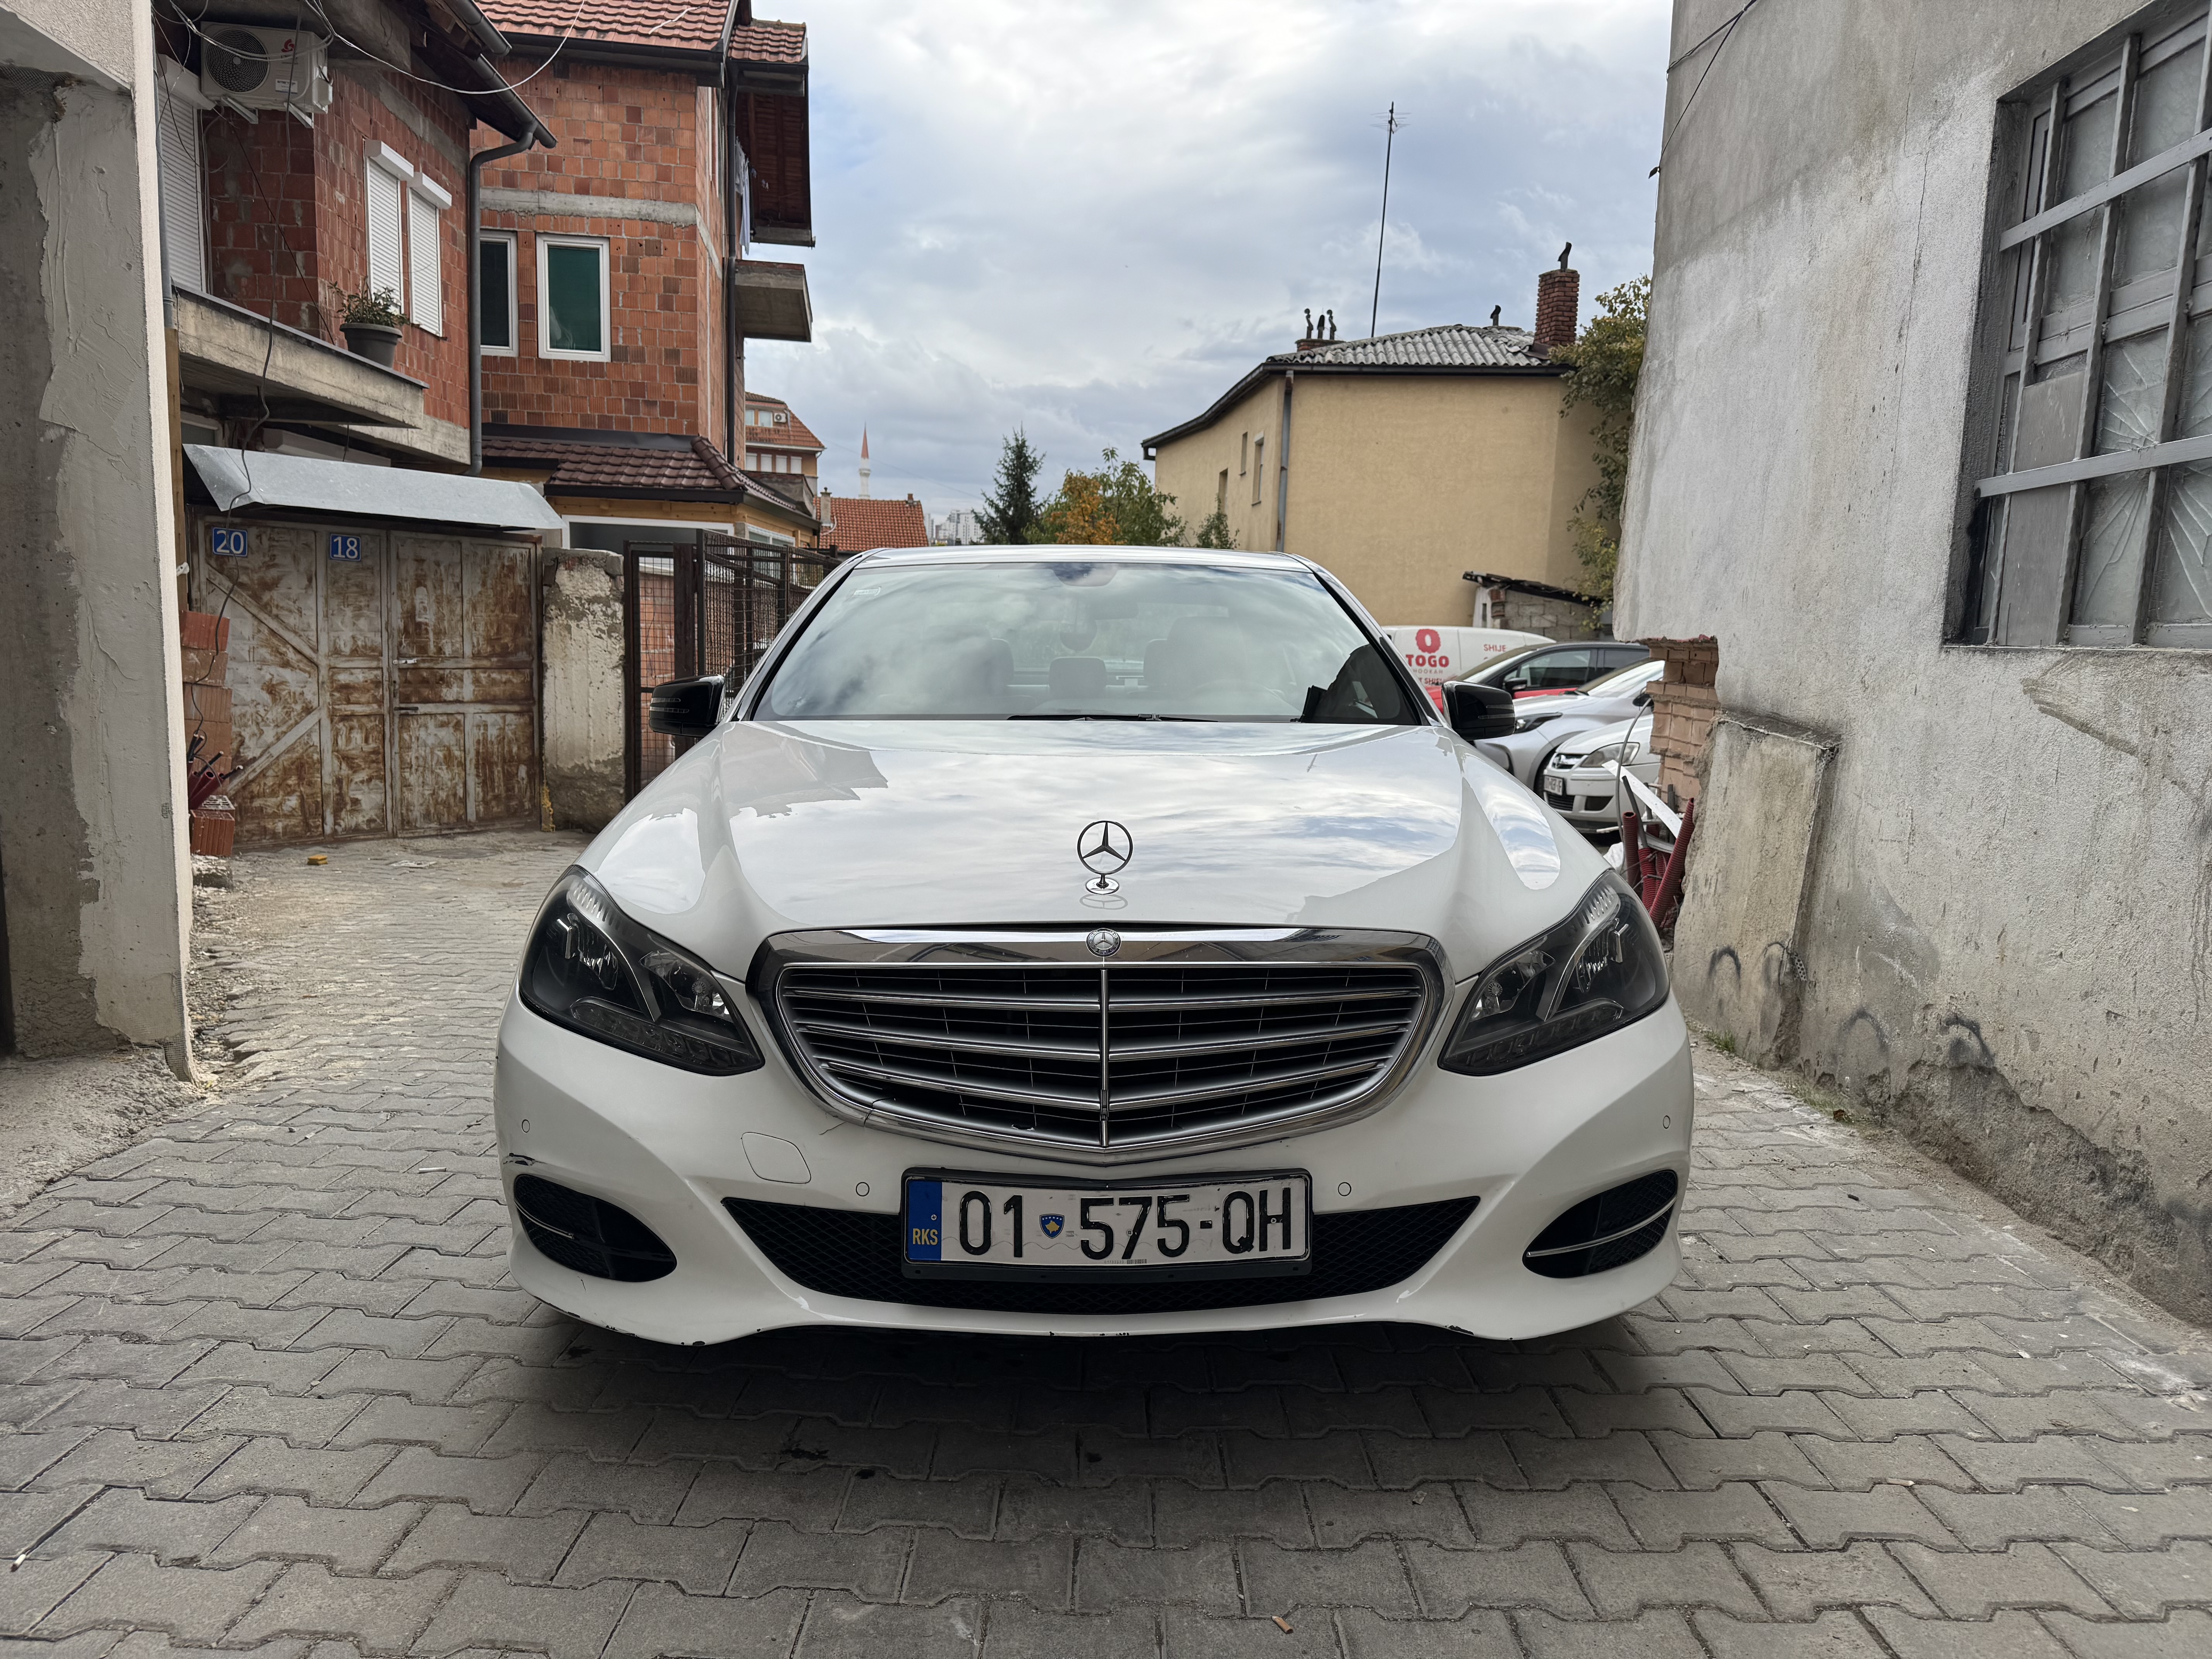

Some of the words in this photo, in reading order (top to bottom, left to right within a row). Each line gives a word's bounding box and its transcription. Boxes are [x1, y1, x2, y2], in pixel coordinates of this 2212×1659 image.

[216, 530, 244, 554] 20
[333, 536, 358, 558] 18
[1484, 644, 1506, 652] SHIJE
[1406, 654, 1449, 667] TOGO
[960, 1191, 1022, 1257] 01
[1080, 1187, 1291, 1260] 575-QH
[913, 1228, 938, 1245] RKS
